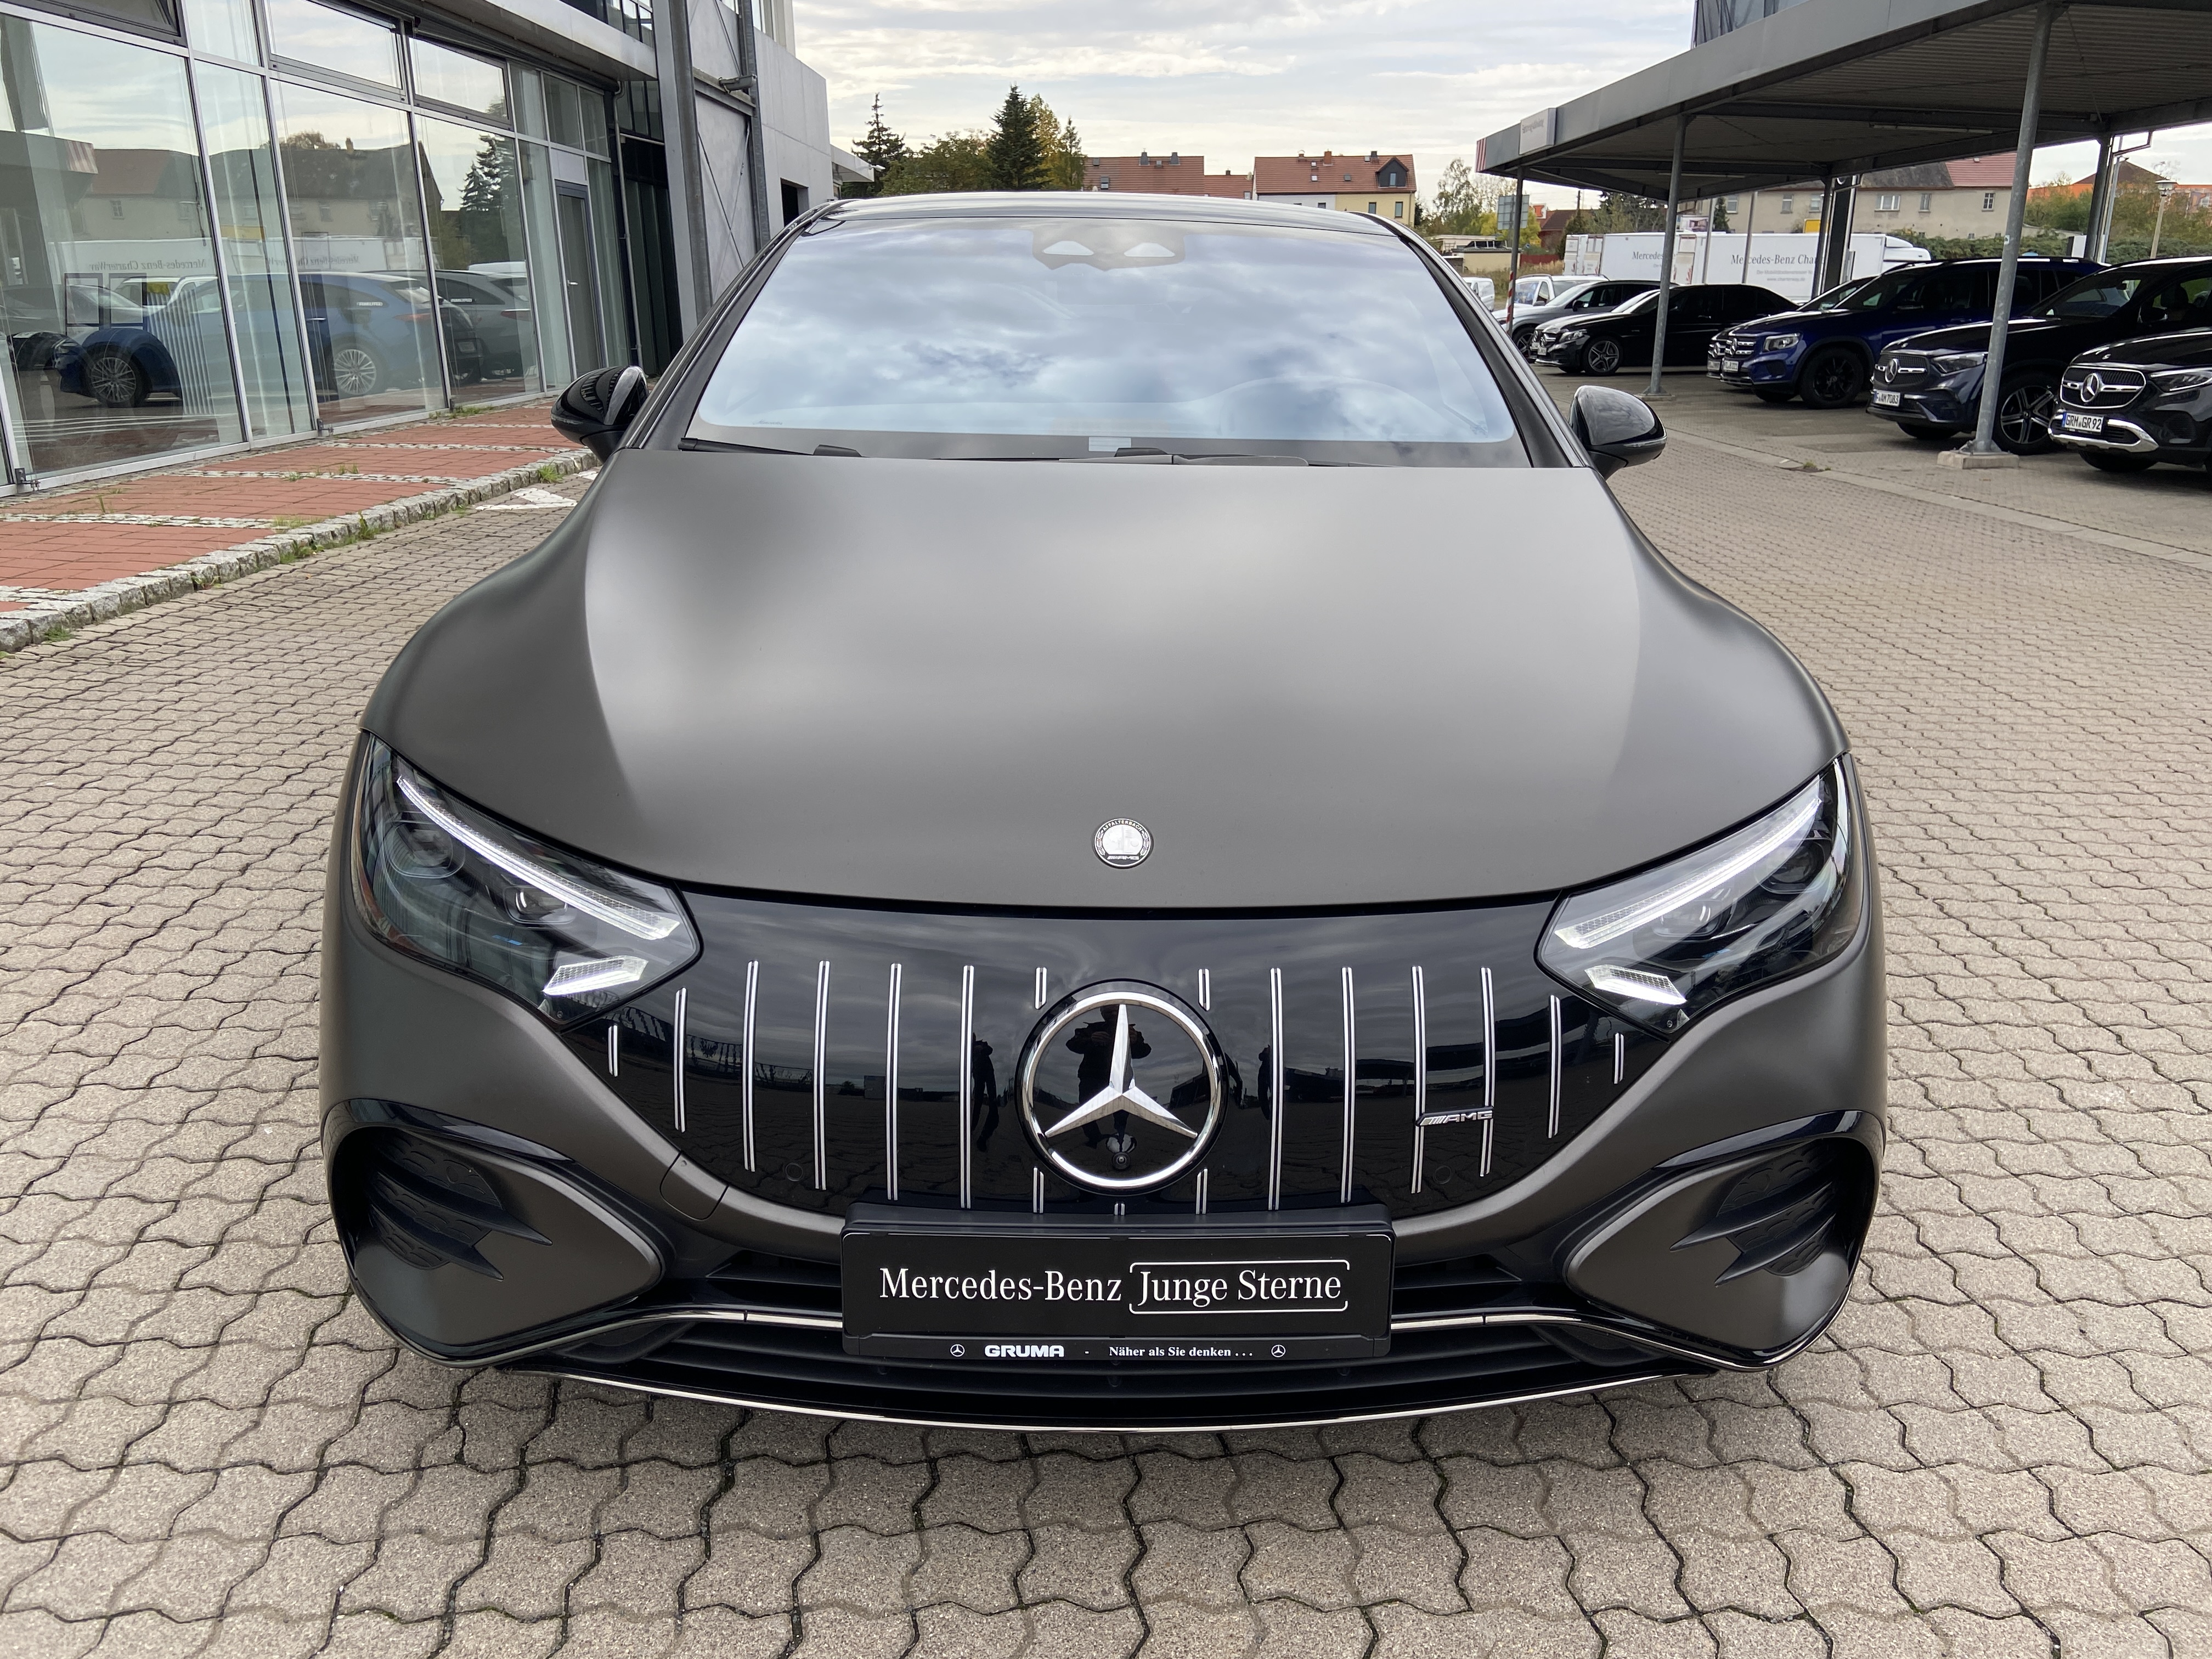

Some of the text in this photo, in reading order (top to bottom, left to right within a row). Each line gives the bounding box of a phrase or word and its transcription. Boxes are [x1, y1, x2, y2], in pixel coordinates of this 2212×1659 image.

[1731, 254, 1815, 265] Mecedes-Benz Cha
[2082, 417, 2092, 429] GR
[2092, 418, 2102, 430] 92
[1103, 820, 1143, 831] AFFALTERBACH
[1442, 1110, 1493, 1124] AMG
[879, 1267, 1341, 1308] Mercedes-Benz Junge Sterne
[984, 1345, 1064, 1358] GRUMA
[1109, 1346, 1146, 1357] Näher
[1148, 1346, 1165, 1357] als
[1167, 1346, 1186, 1357] Sie
[1189, 1346, 1231, 1357] denken
